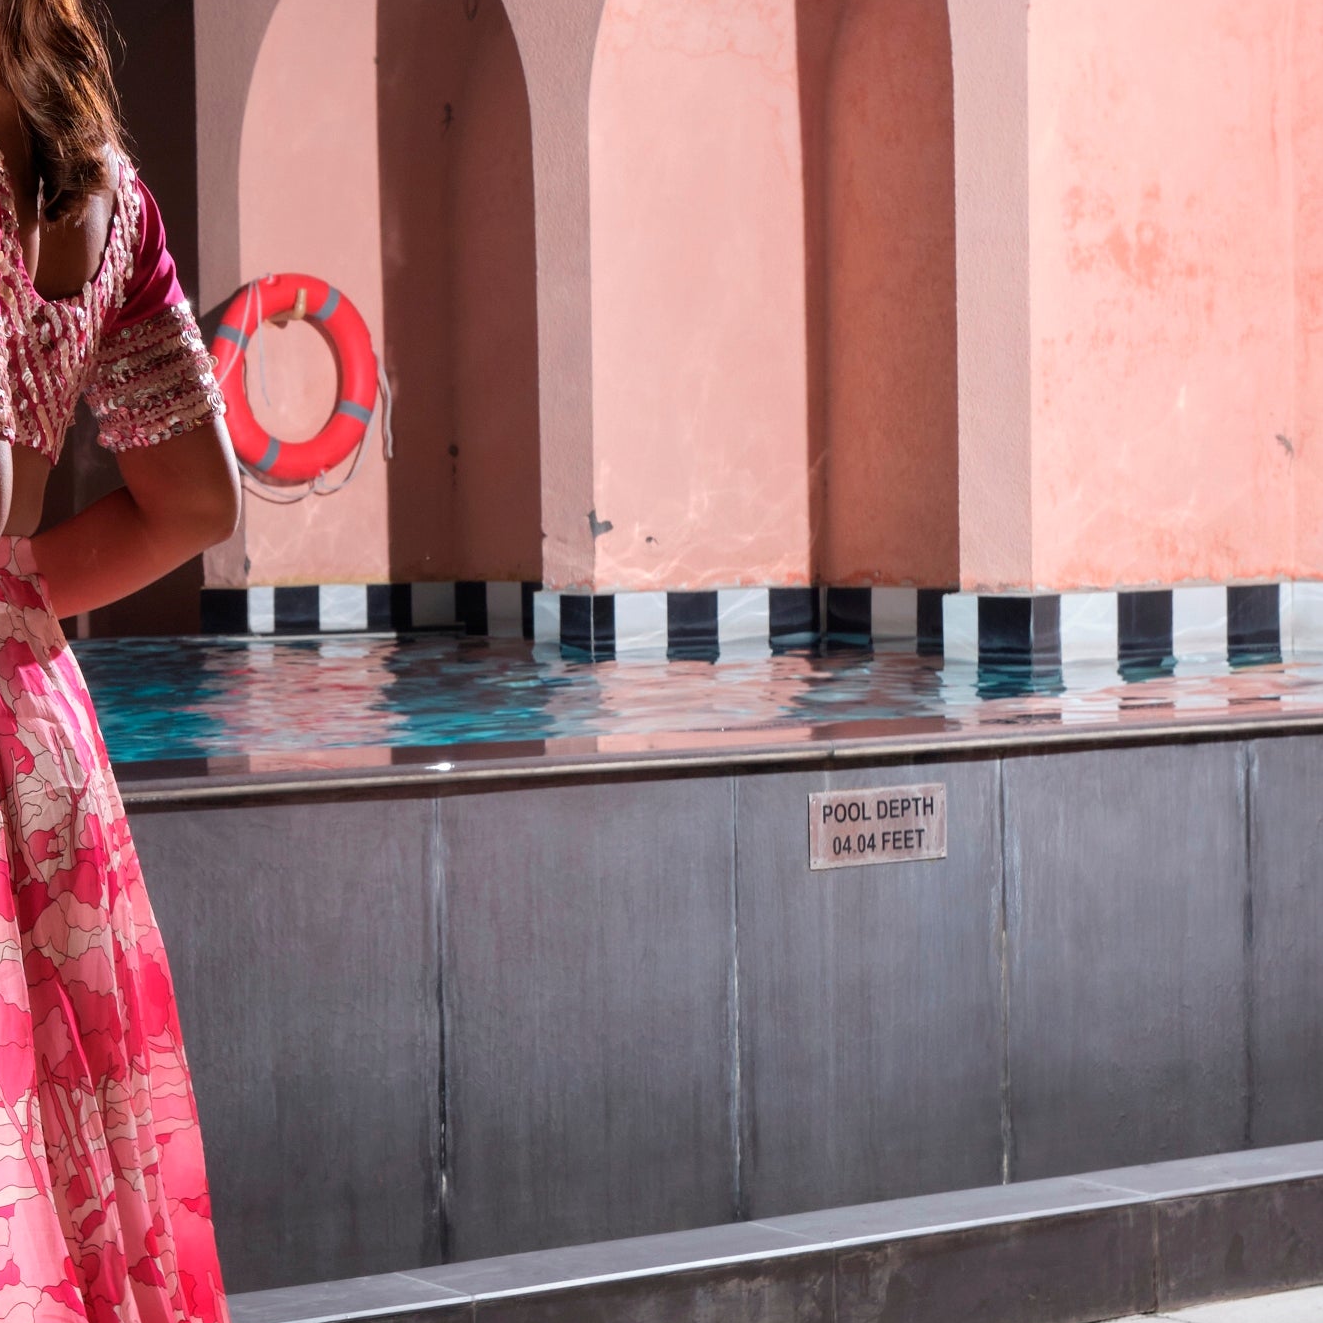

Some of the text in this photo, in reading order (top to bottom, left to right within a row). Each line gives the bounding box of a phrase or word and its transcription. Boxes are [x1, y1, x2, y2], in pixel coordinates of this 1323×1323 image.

[822, 796, 934, 823] POOL DEPTH
[833, 829, 925, 855] 04.04 FEET
